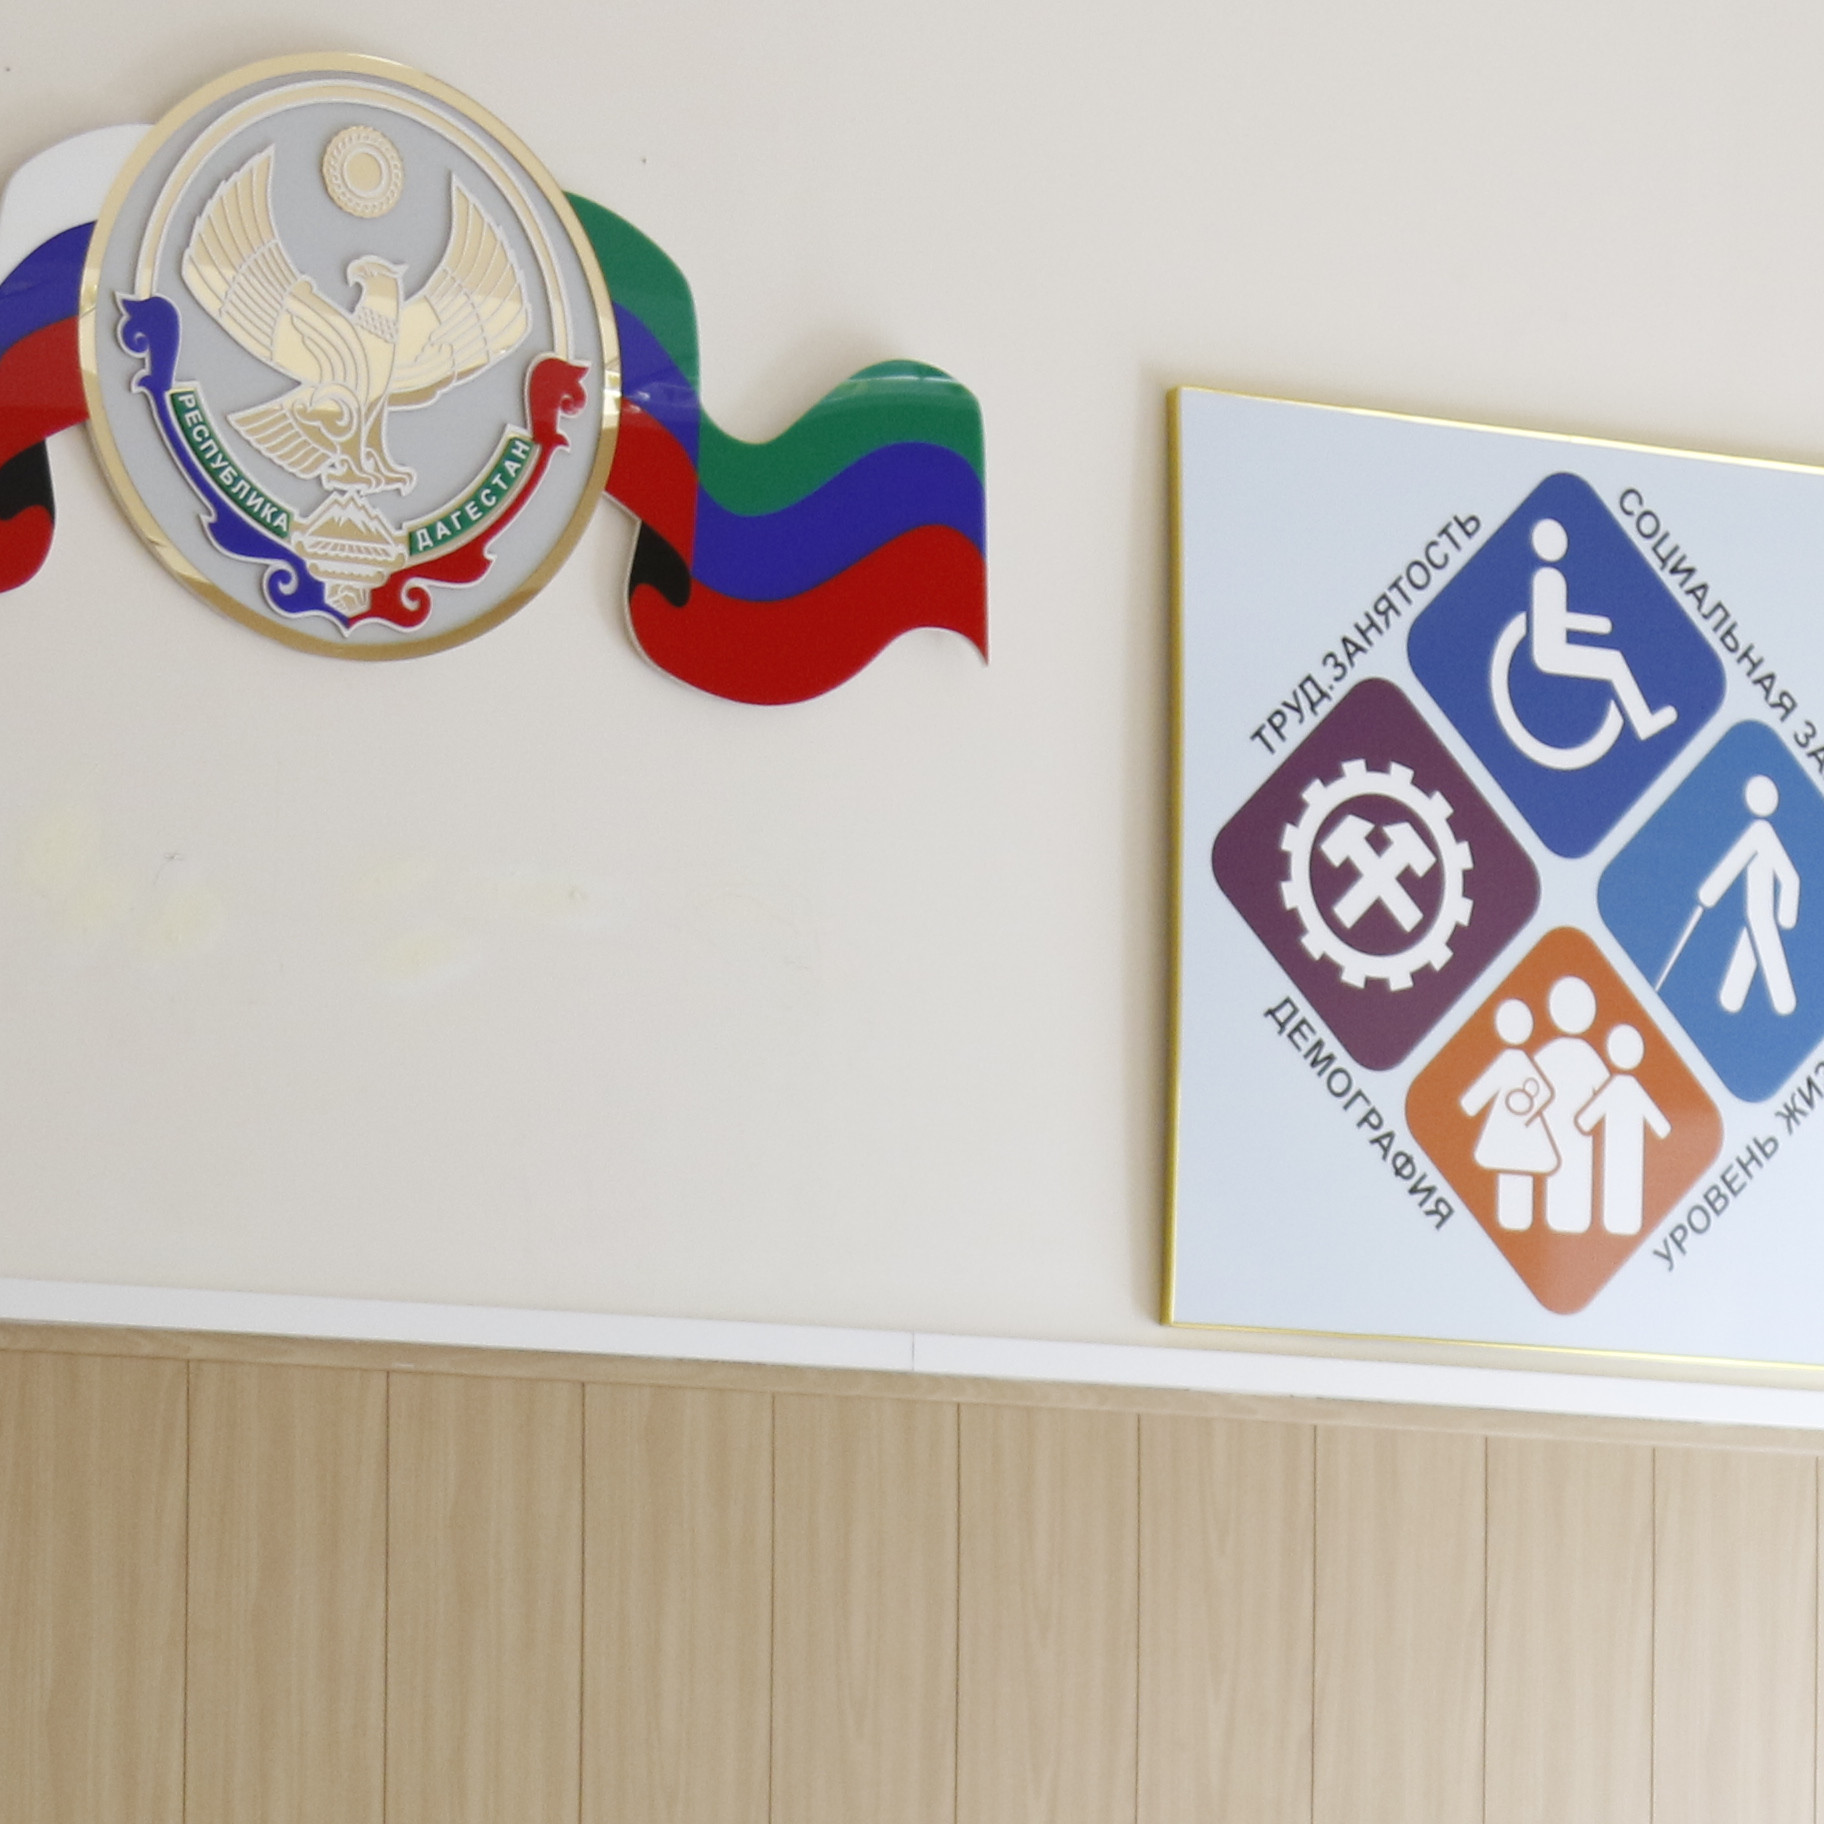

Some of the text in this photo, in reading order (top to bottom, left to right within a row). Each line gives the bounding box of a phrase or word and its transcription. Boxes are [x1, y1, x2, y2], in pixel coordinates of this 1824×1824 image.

[178, 392, 291, 533] РЕСПУБЛИКА
[416, 439, 531, 552] ДАГЕСТАН
[1249, 508, 1482, 758] ТРУД.ЗАНЯТОСТЬ
[1617, 486, 1798, 722] СОЦИАЛЬНАЯ
[1263, 995, 1455, 1231] ДЕМОГРАФИЯ
[1651, 1134, 1779, 1272] УРОВЕНЬ
